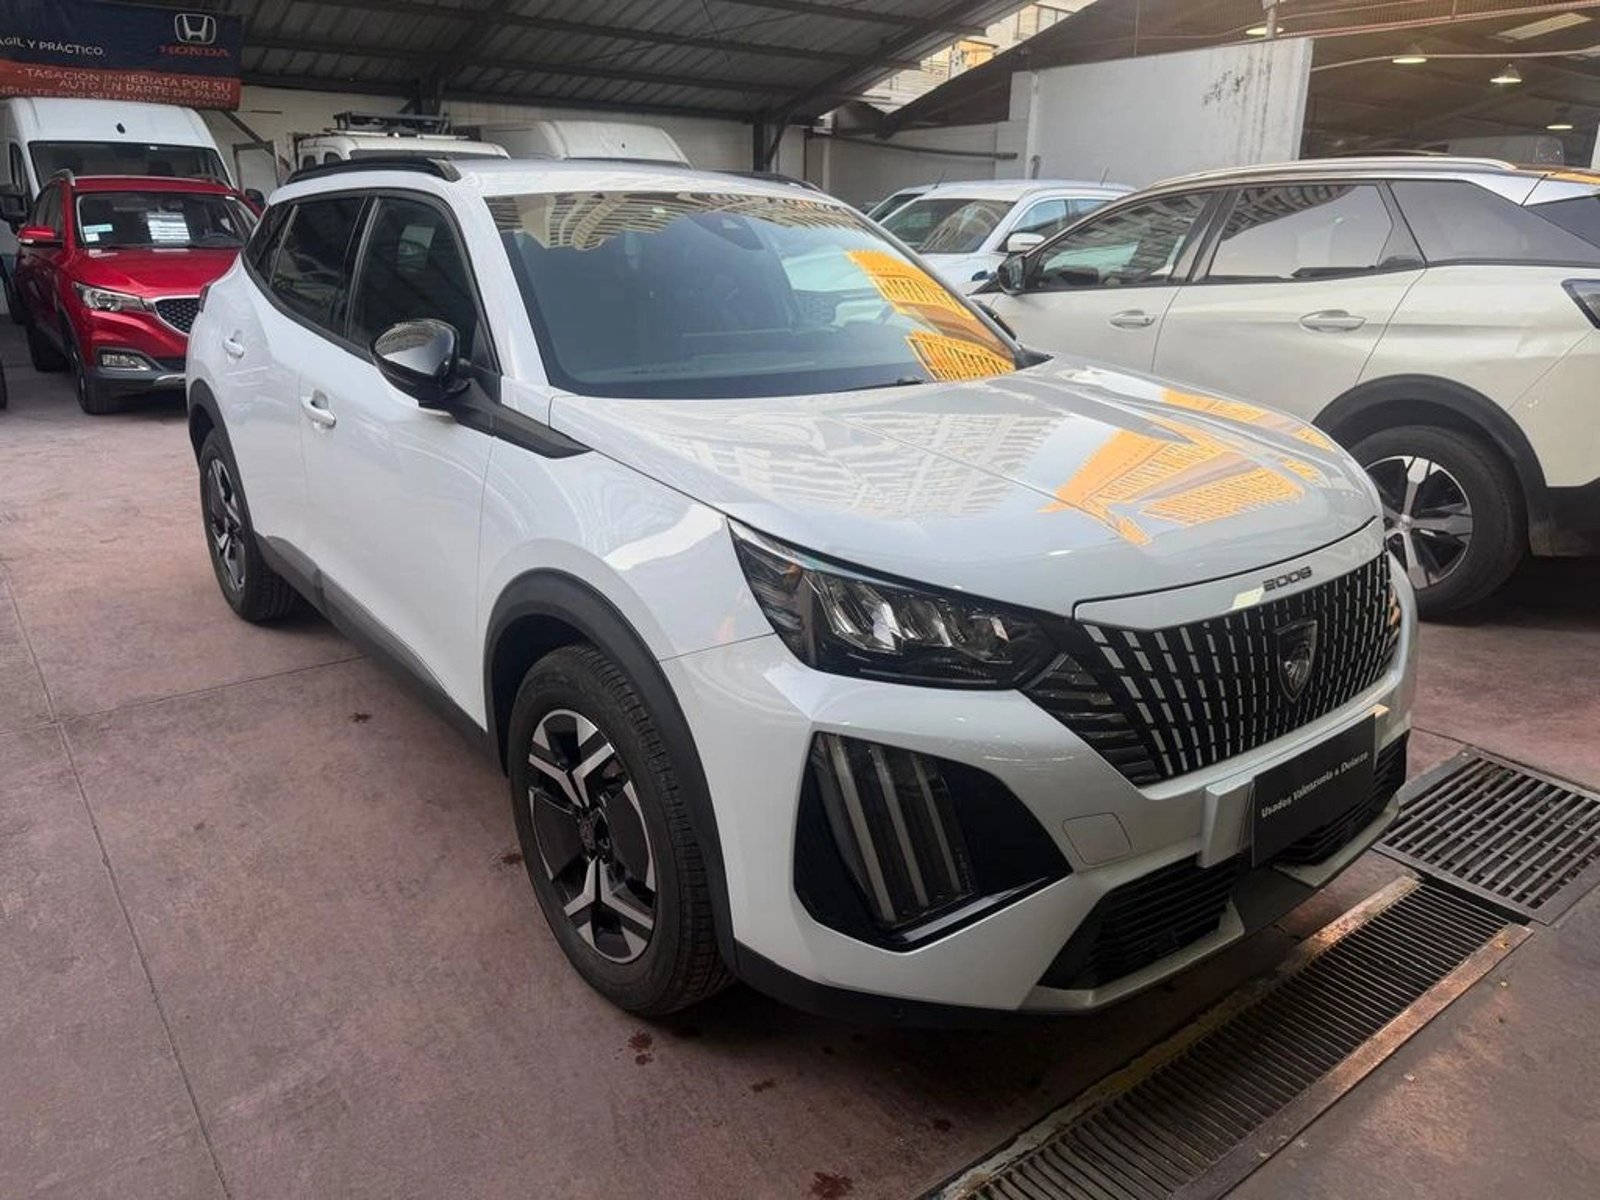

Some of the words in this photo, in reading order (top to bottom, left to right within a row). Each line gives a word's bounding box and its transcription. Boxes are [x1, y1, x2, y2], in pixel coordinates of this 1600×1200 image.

[27, 40, 36, 48] Y
[158, 45, 231, 57] HONDA
[59, 80, 99, 90] AUTO
[103, 82, 121, 91] EN
[126, 84, 169, 96] PARTE
[173, 88, 191, 98] DE
[195, 91, 231, 101] PAGO
[103, 74, 179, 87] INMEDIATA
[182, 80, 209, 90] POR
[213, 82, 231, 92] SU
[1263, 566, 1312, 592] 2008
[1261, 796, 1292, 818] Usados
[1293, 770, 1334, 800] Valenzuela
